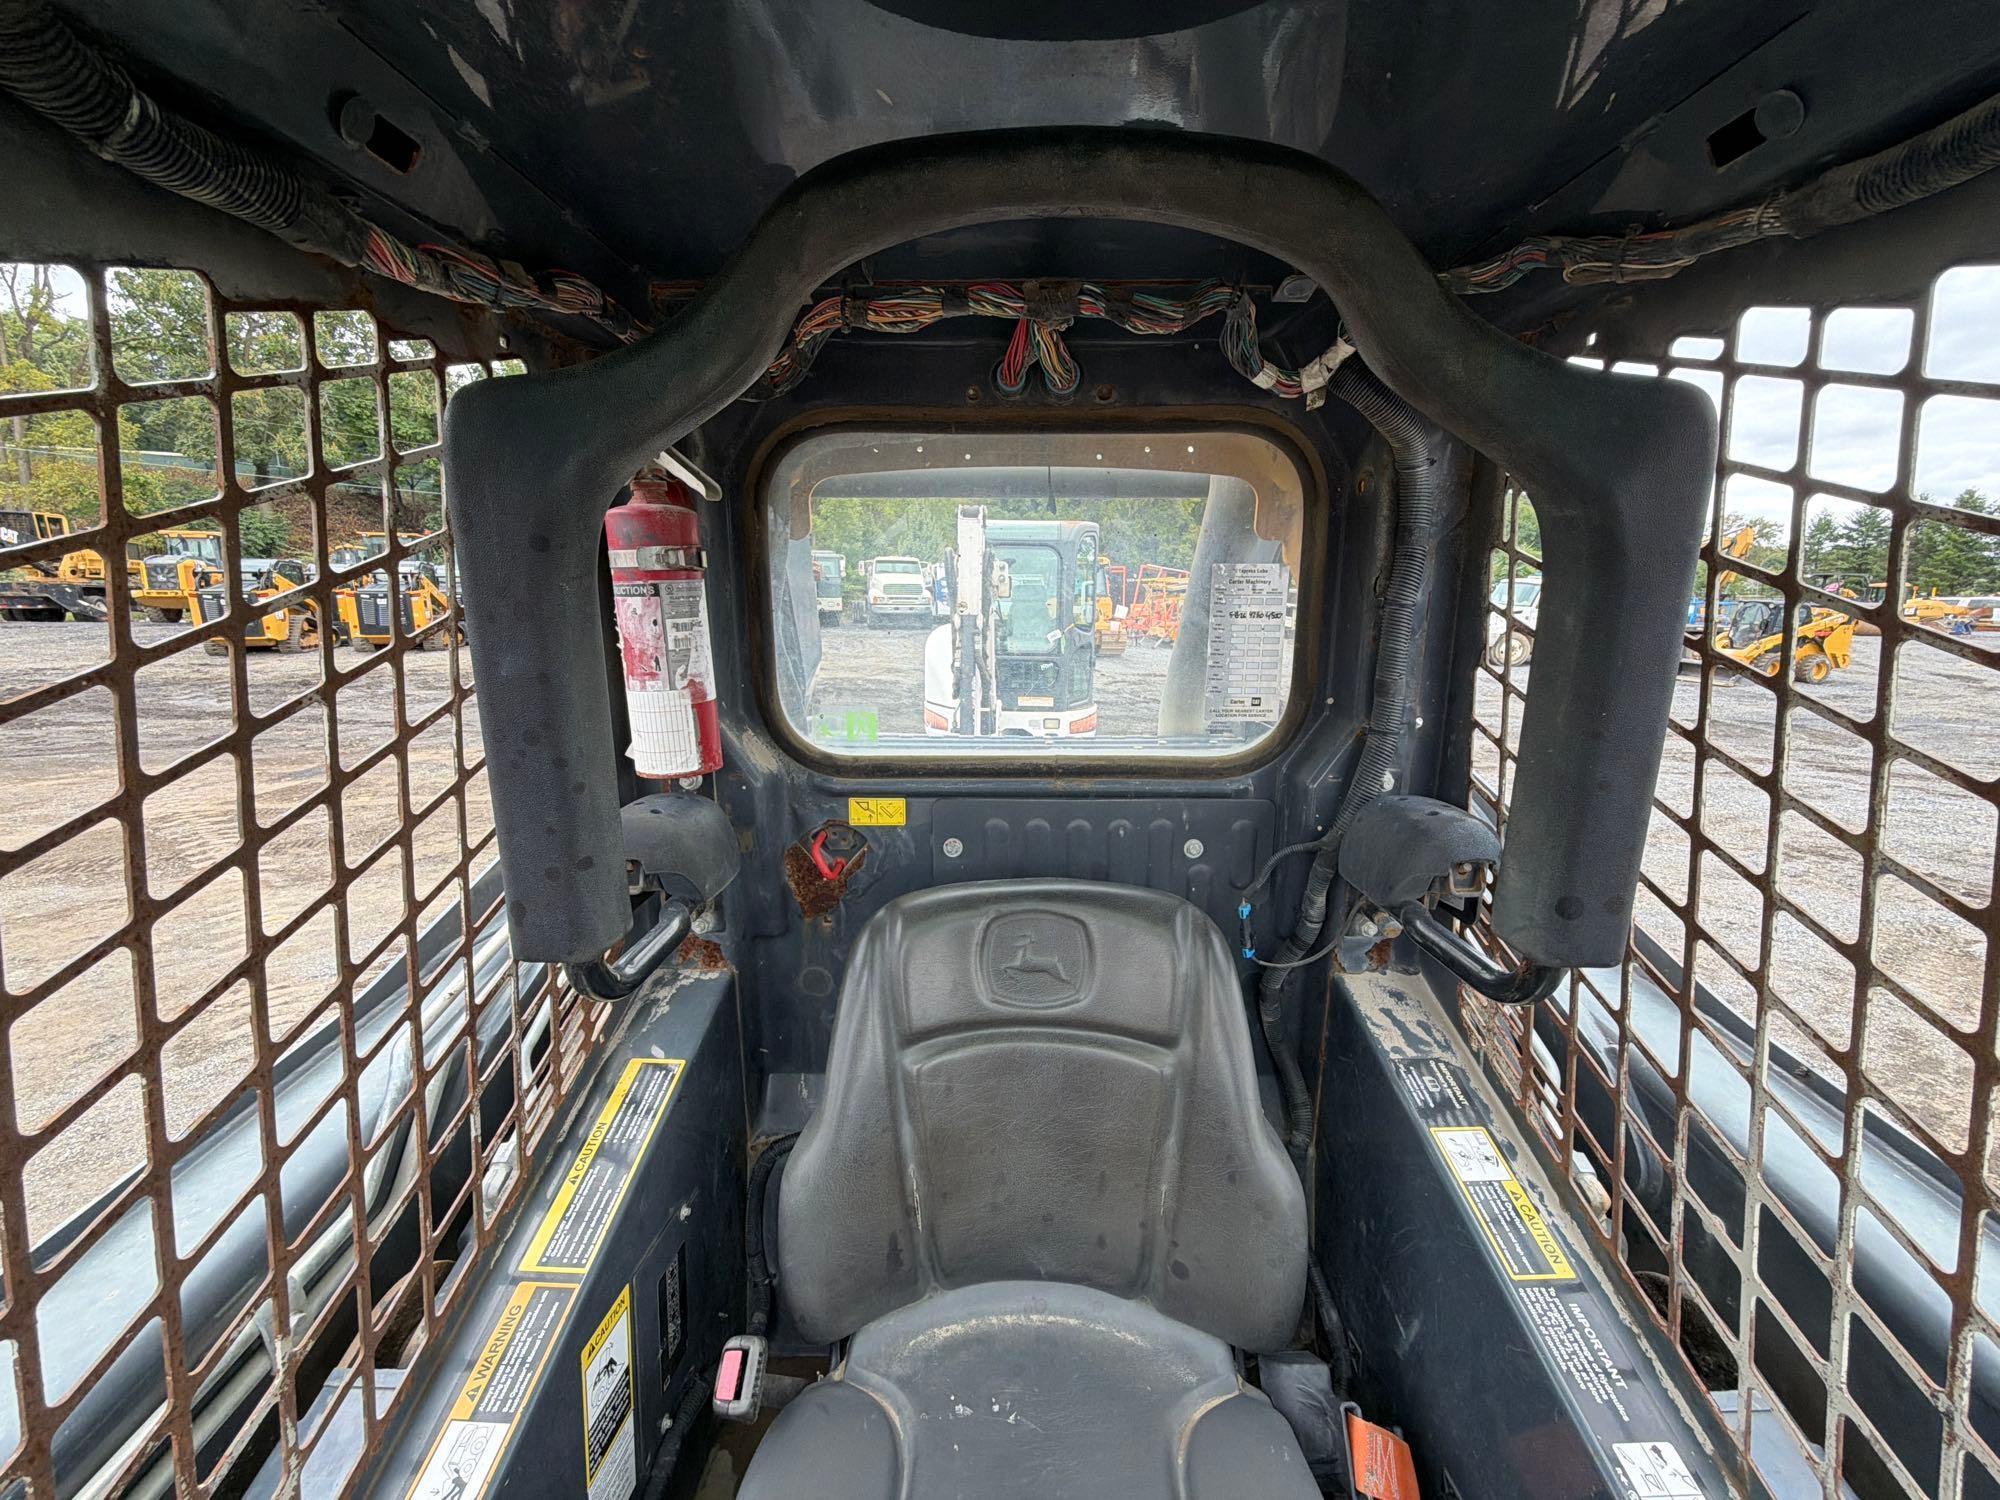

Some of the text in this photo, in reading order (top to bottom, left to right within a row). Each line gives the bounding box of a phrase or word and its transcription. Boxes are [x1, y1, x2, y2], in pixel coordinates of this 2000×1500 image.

[1438, 1063, 1468, 1105] IMPORTANT
[575, 1122, 606, 1171] CAUTION
[1492, 1181, 1508, 1200] Avoid
[1504, 1202, 1526, 1233] Overturn
[1520, 1204, 1561, 1263] CAUTION
[474, 1305, 521, 1380] WARNING
[595, 1295, 625, 1345] CAUTION
[1518, 1288, 1541, 1324] operation
[1539, 1325, 1549, 1334] of
[1540, 1287, 1552, 1301] and
[1566, 1333, 1574, 1341] in
[1572, 1343, 1607, 1399] temperatures
[1532, 1287, 1548, 1309] below
[1571, 1355, 1582, 1370] run
[1580, 1371, 1590, 1380] at
[1586, 1382, 1602, 1403] slow
[1534, 1302, 1544, 1314] for
[1541, 1315, 1551, 1325] 10
[1547, 1326, 1569, 1359] minutes
[1567, 1361, 1586, 1389] before
[1548, 1287, 1629, 1421] To prevent damage of hydraulics
[1569, 1303, 1628, 1389] IMPORTANT
